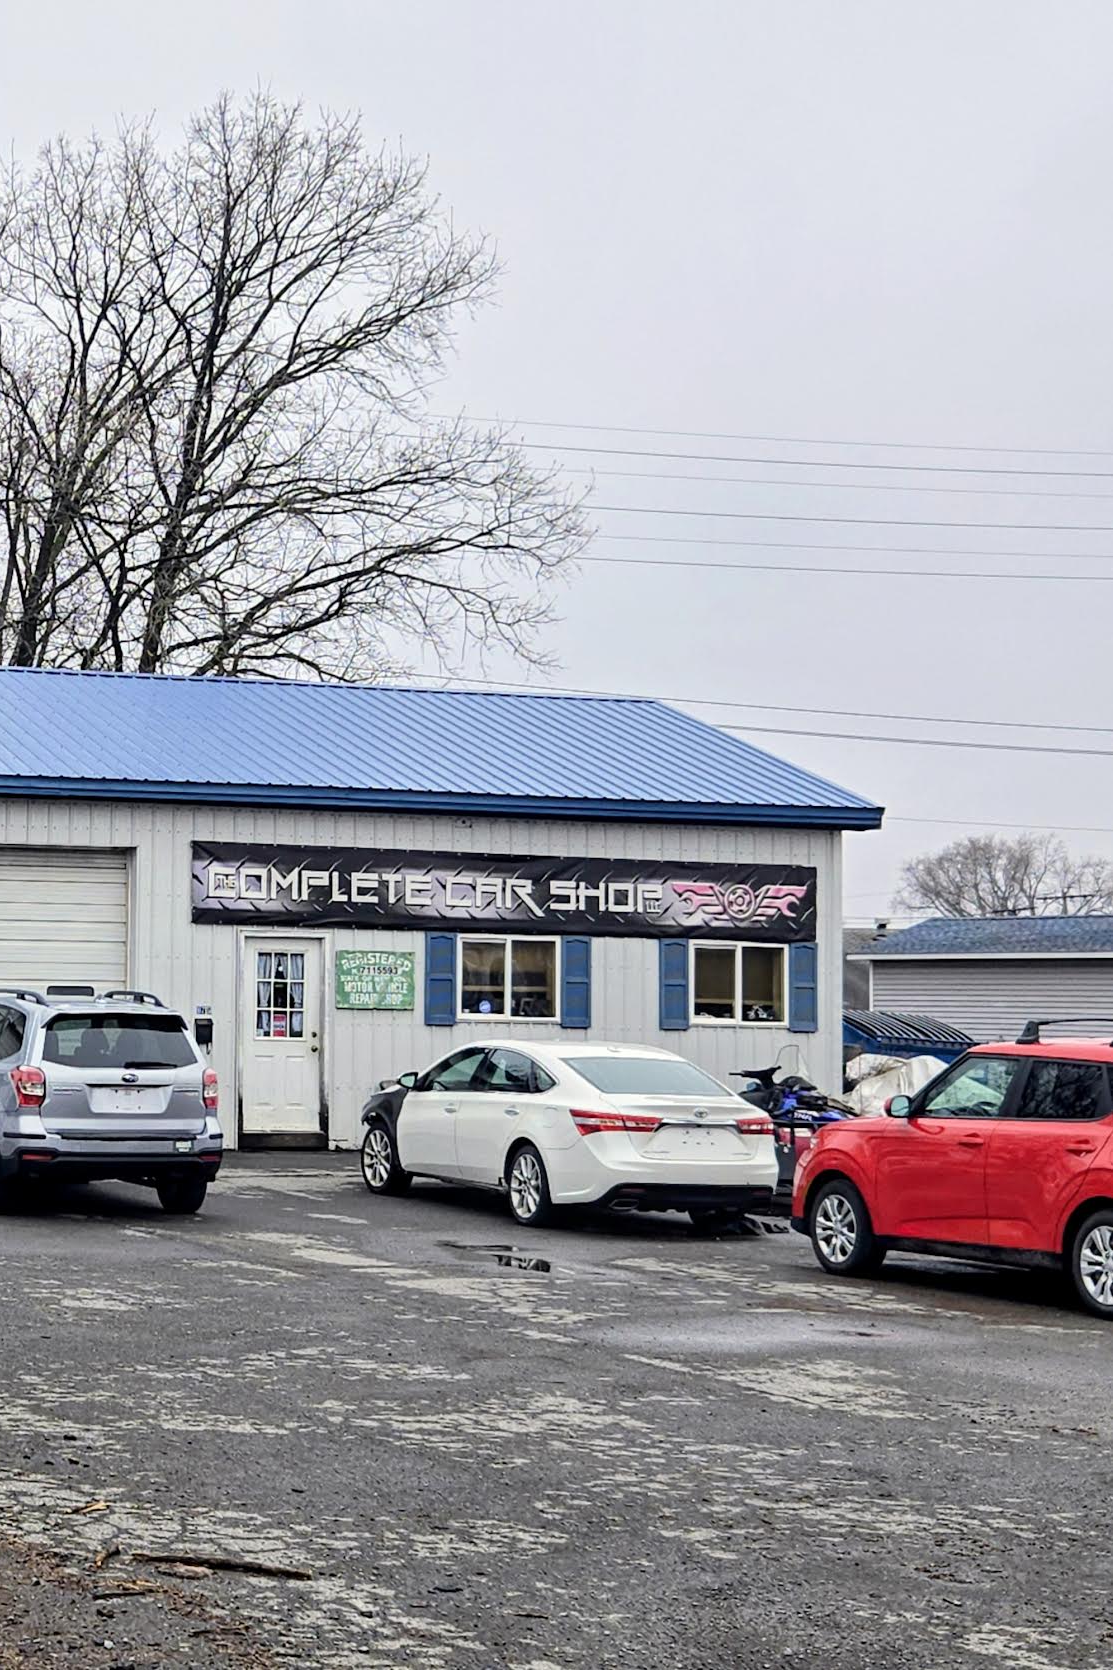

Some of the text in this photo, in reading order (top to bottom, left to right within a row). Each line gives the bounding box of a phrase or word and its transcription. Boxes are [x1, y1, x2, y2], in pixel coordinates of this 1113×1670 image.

[207, 866, 664, 918] COMPLETE CAR SHOP
[341, 952, 412, 972] REGISTERED
[361, 966, 398, 975] 7115593
[344, 981, 374, 993] MOTOR
